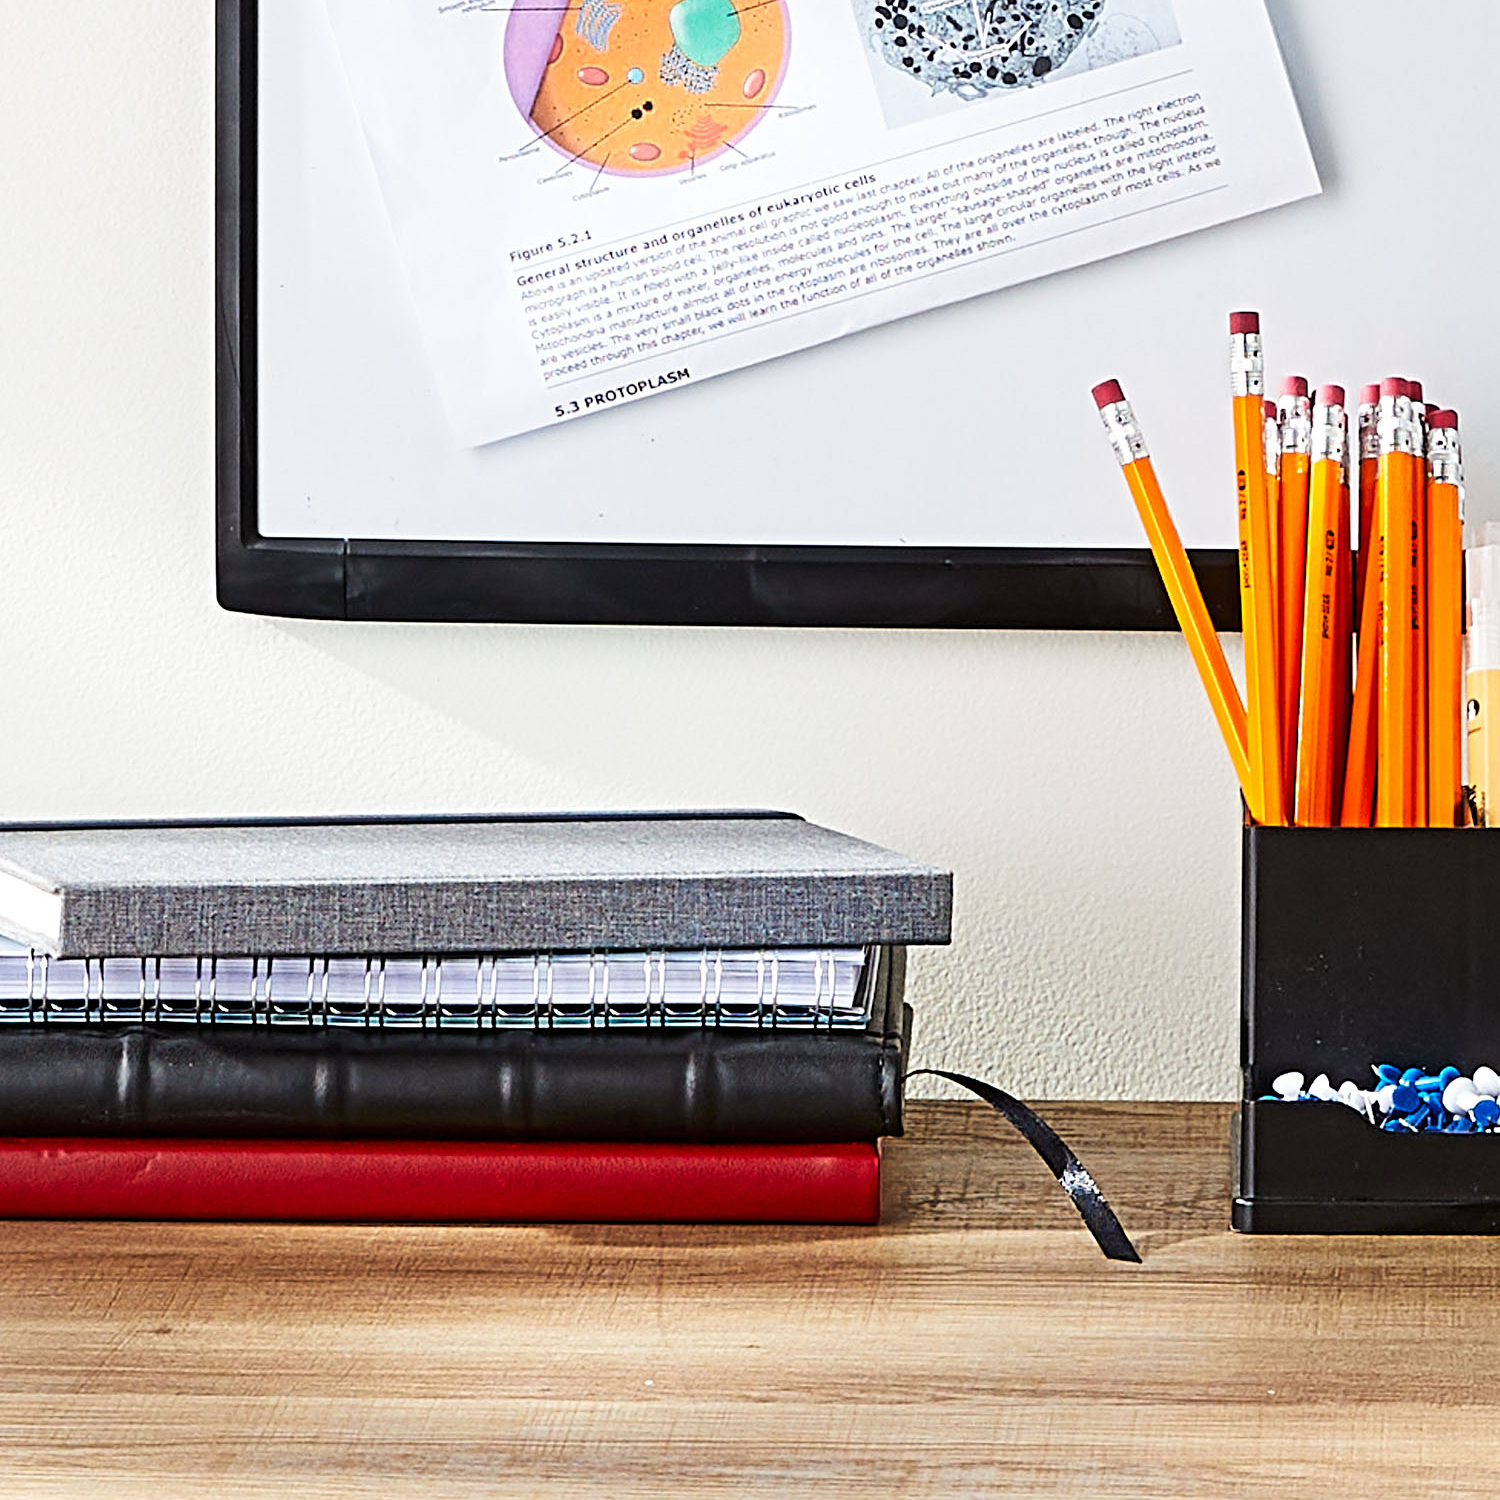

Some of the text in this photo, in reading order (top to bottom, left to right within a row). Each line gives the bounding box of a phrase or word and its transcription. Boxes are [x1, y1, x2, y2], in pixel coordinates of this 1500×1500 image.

[509, 230, 592, 262] Figure 5.2.1
[516, 174, 876, 287] General structure and organelles of eukaryotic cells
[555, 368, 690, 417] 5.3 PROTOPLASM
